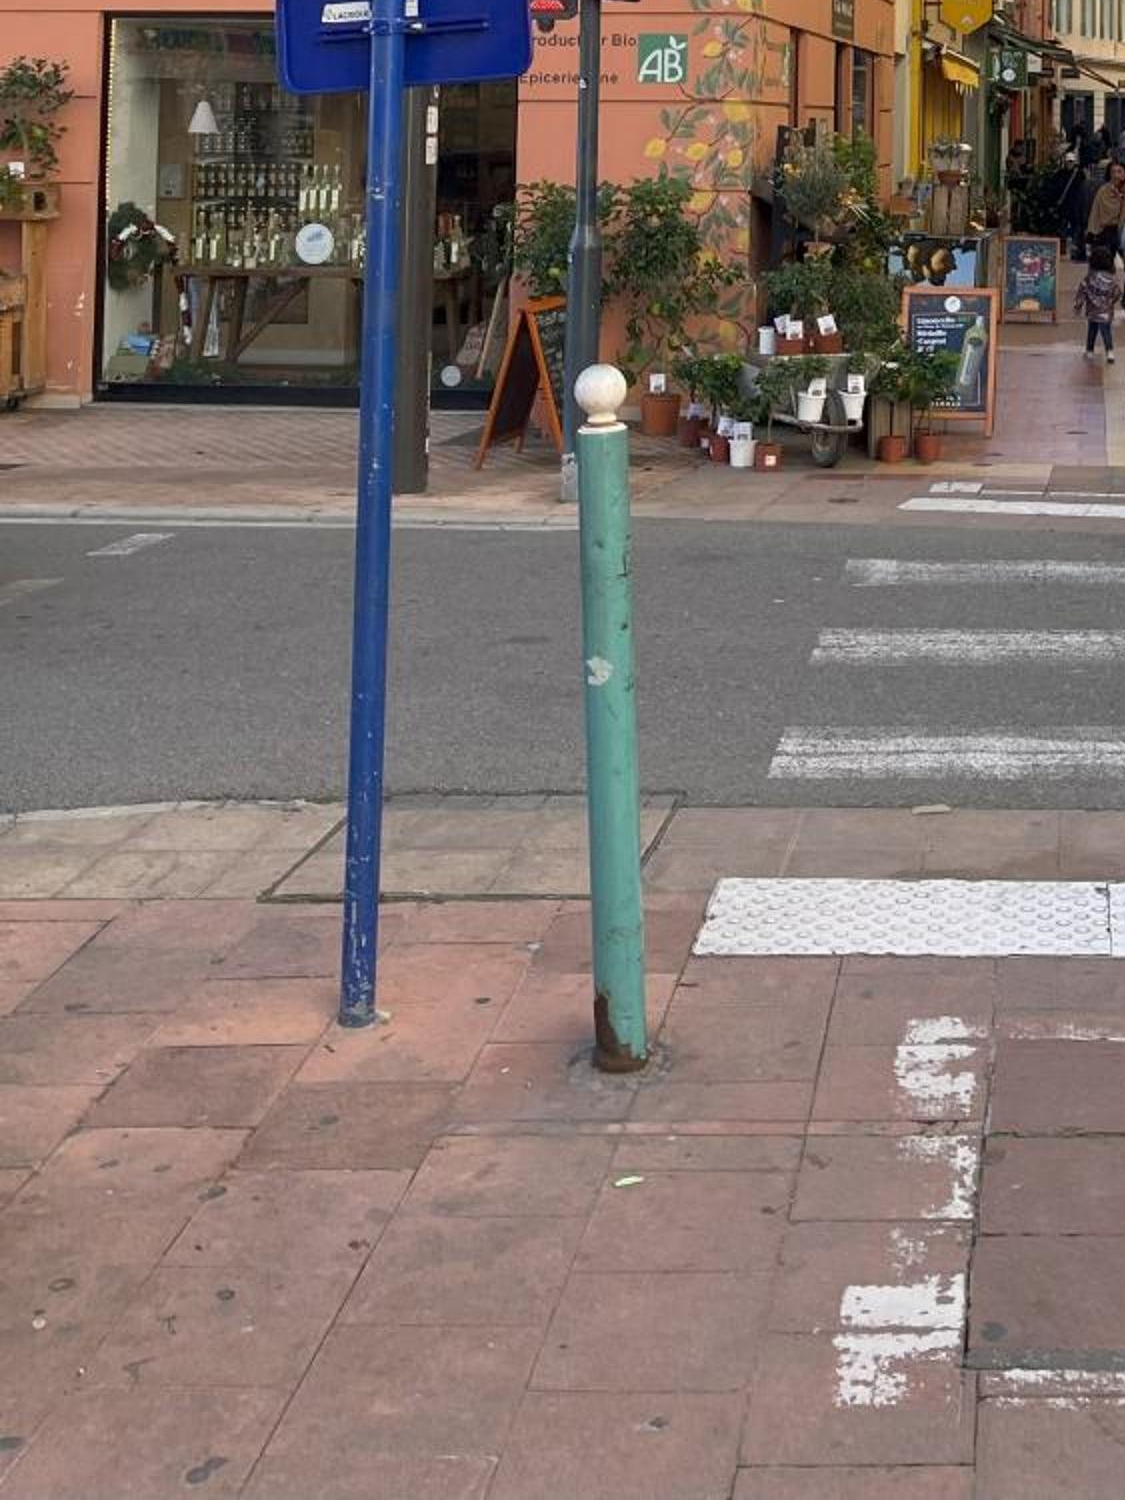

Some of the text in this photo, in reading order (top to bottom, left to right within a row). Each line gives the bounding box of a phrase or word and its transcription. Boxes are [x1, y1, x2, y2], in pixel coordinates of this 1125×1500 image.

[531, 33, 637, 47] roducr Bio
[638, 46, 684, 84] AB
